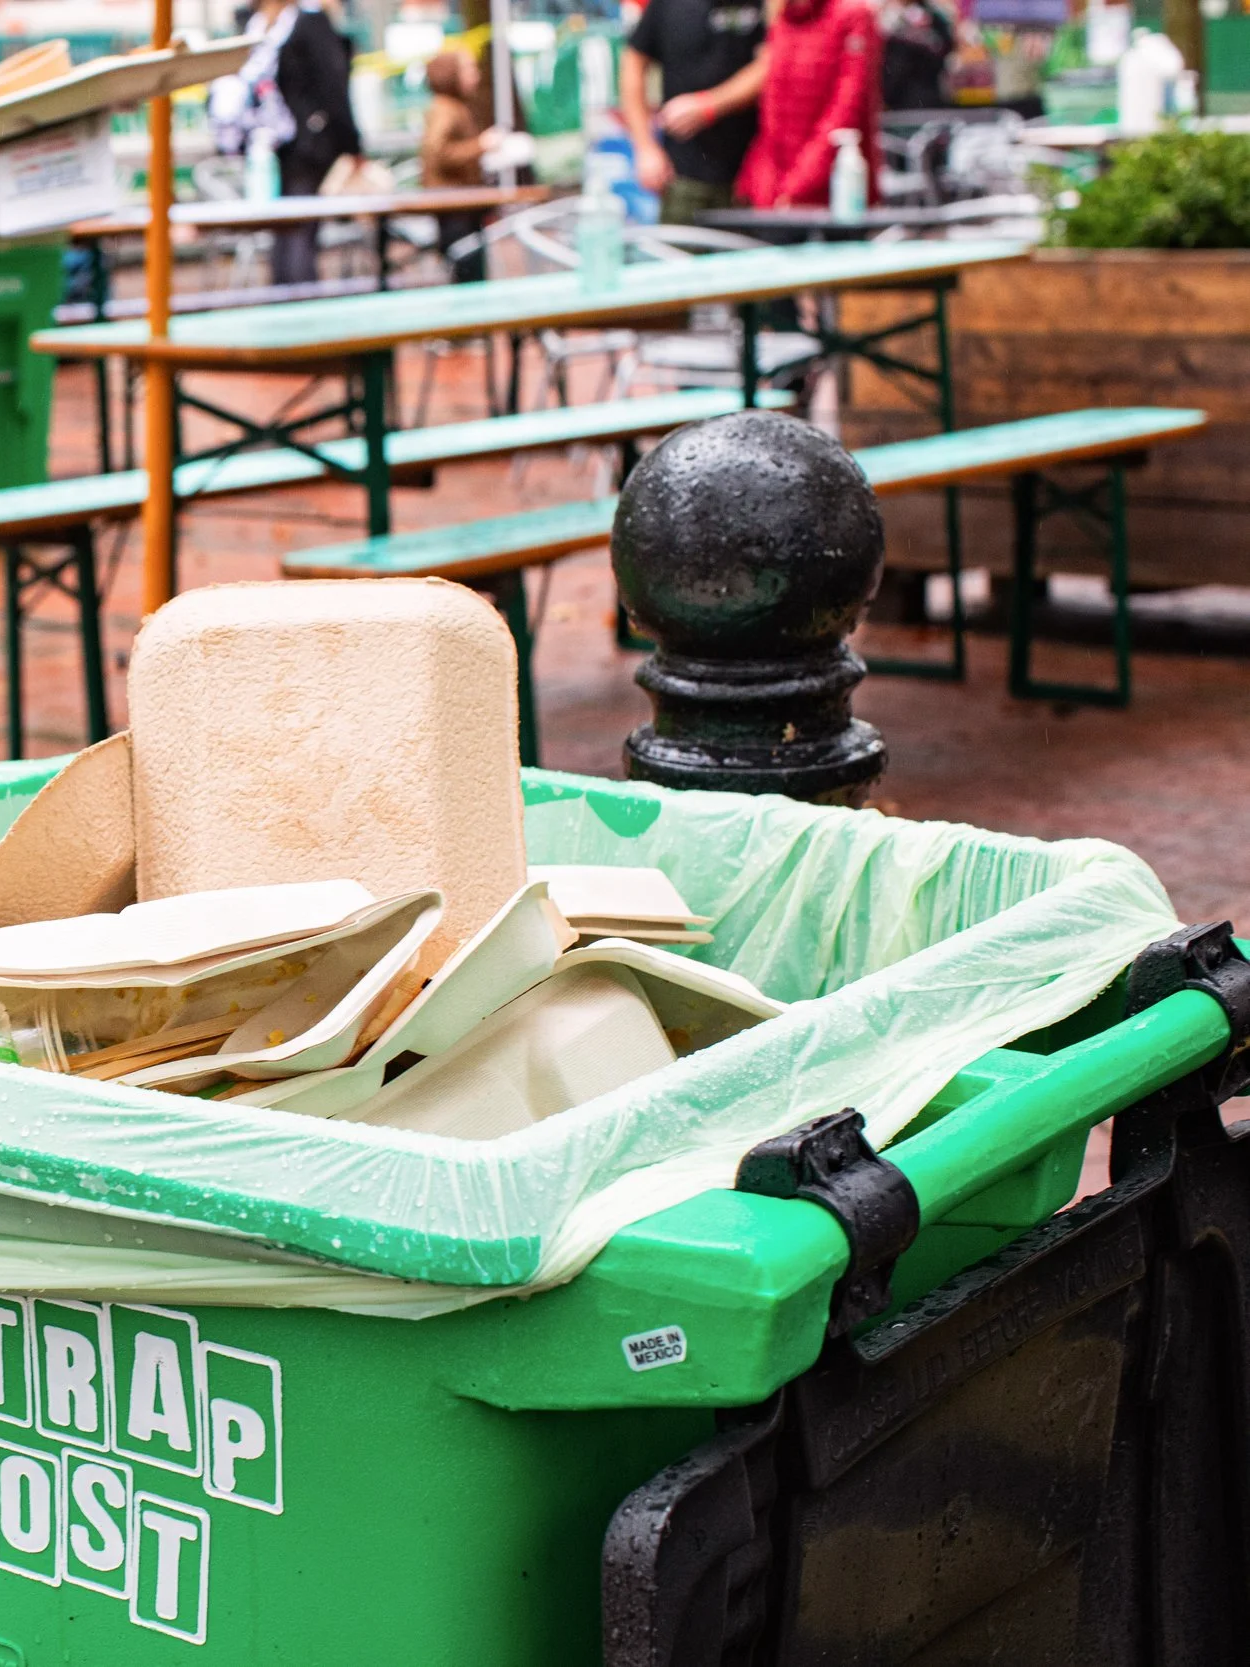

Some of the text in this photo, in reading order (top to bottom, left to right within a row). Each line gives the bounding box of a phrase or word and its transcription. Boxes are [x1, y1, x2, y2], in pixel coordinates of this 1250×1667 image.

[629, 1332, 680, 1354] MADE IN
[634, 1345, 683, 1365] MEXICO
